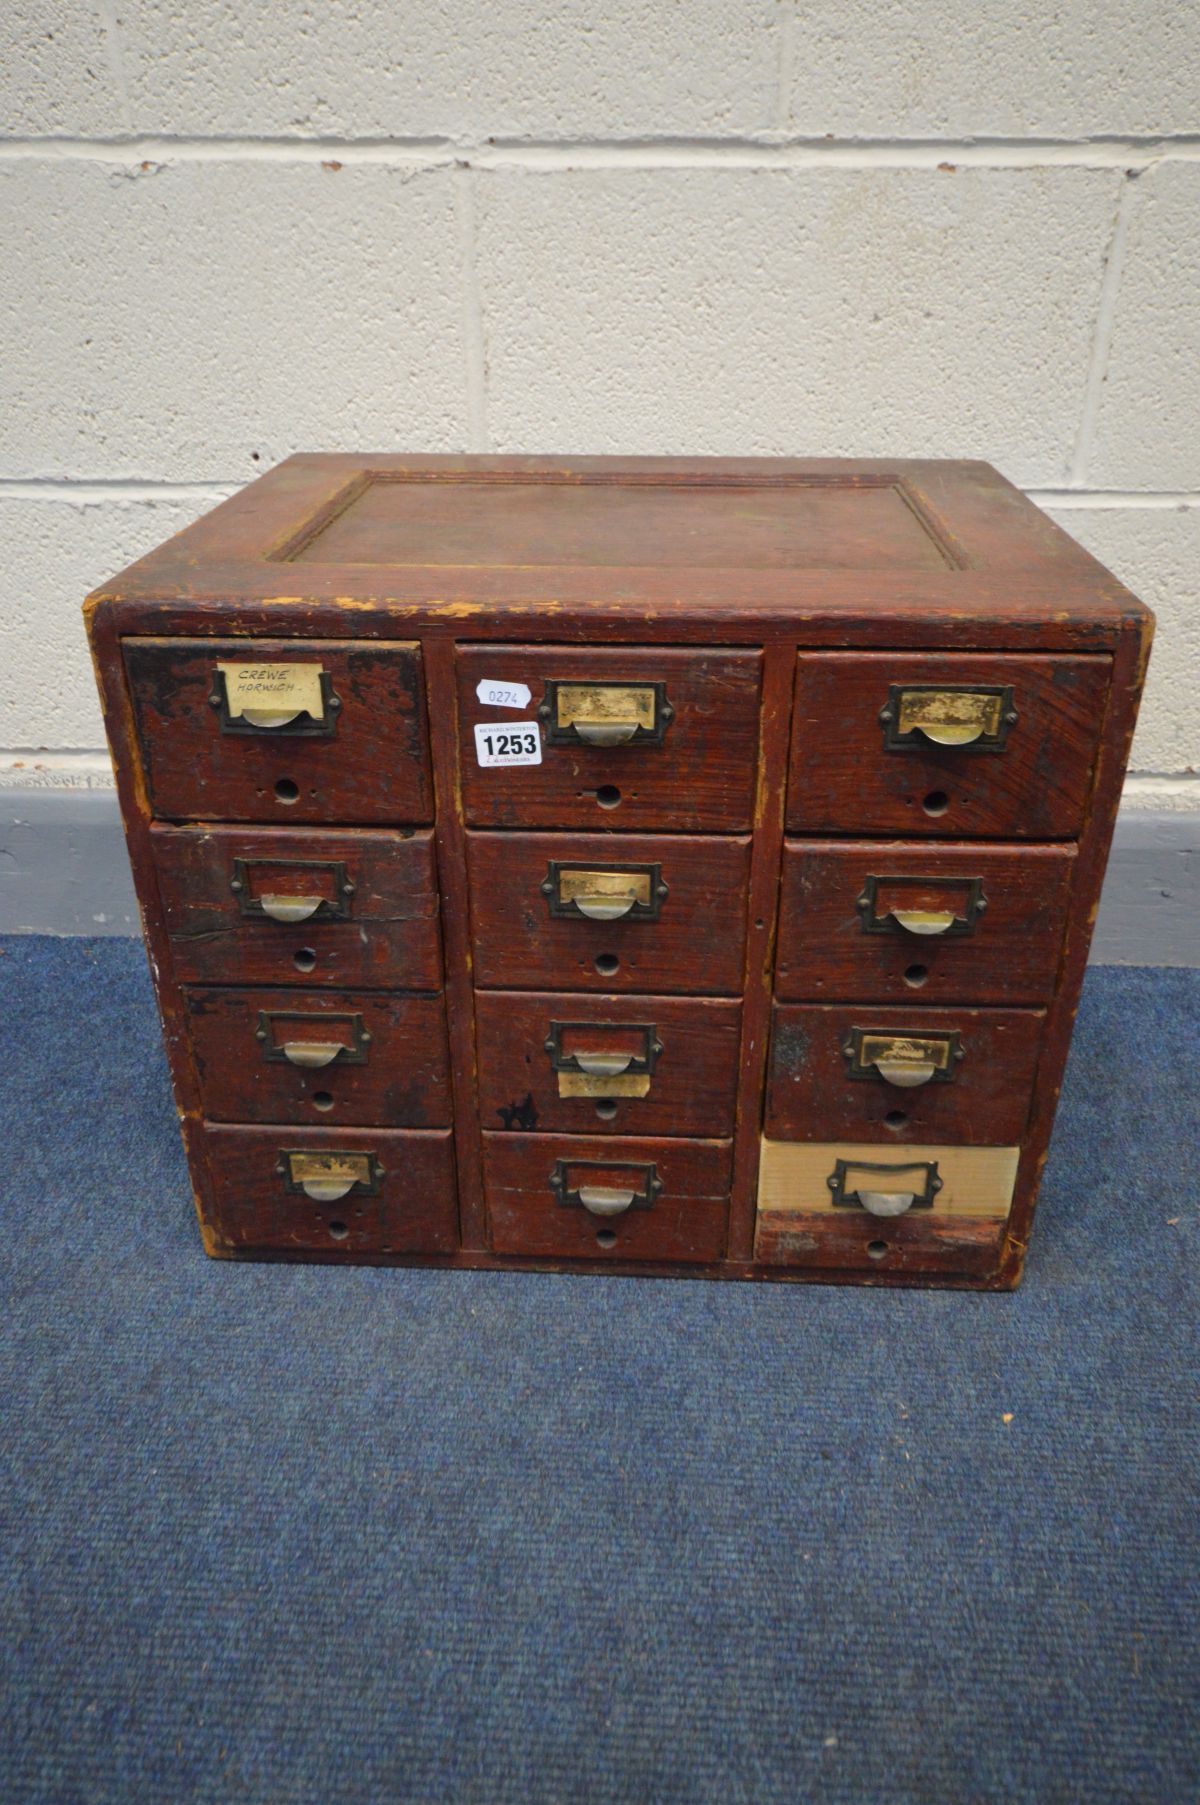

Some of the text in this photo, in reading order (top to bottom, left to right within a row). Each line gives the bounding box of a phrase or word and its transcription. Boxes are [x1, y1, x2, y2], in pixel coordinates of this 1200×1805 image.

[238, 670, 290, 680] CREWE
[488, 691, 518, 704] 0274
[483, 733, 537, 756] 1253
